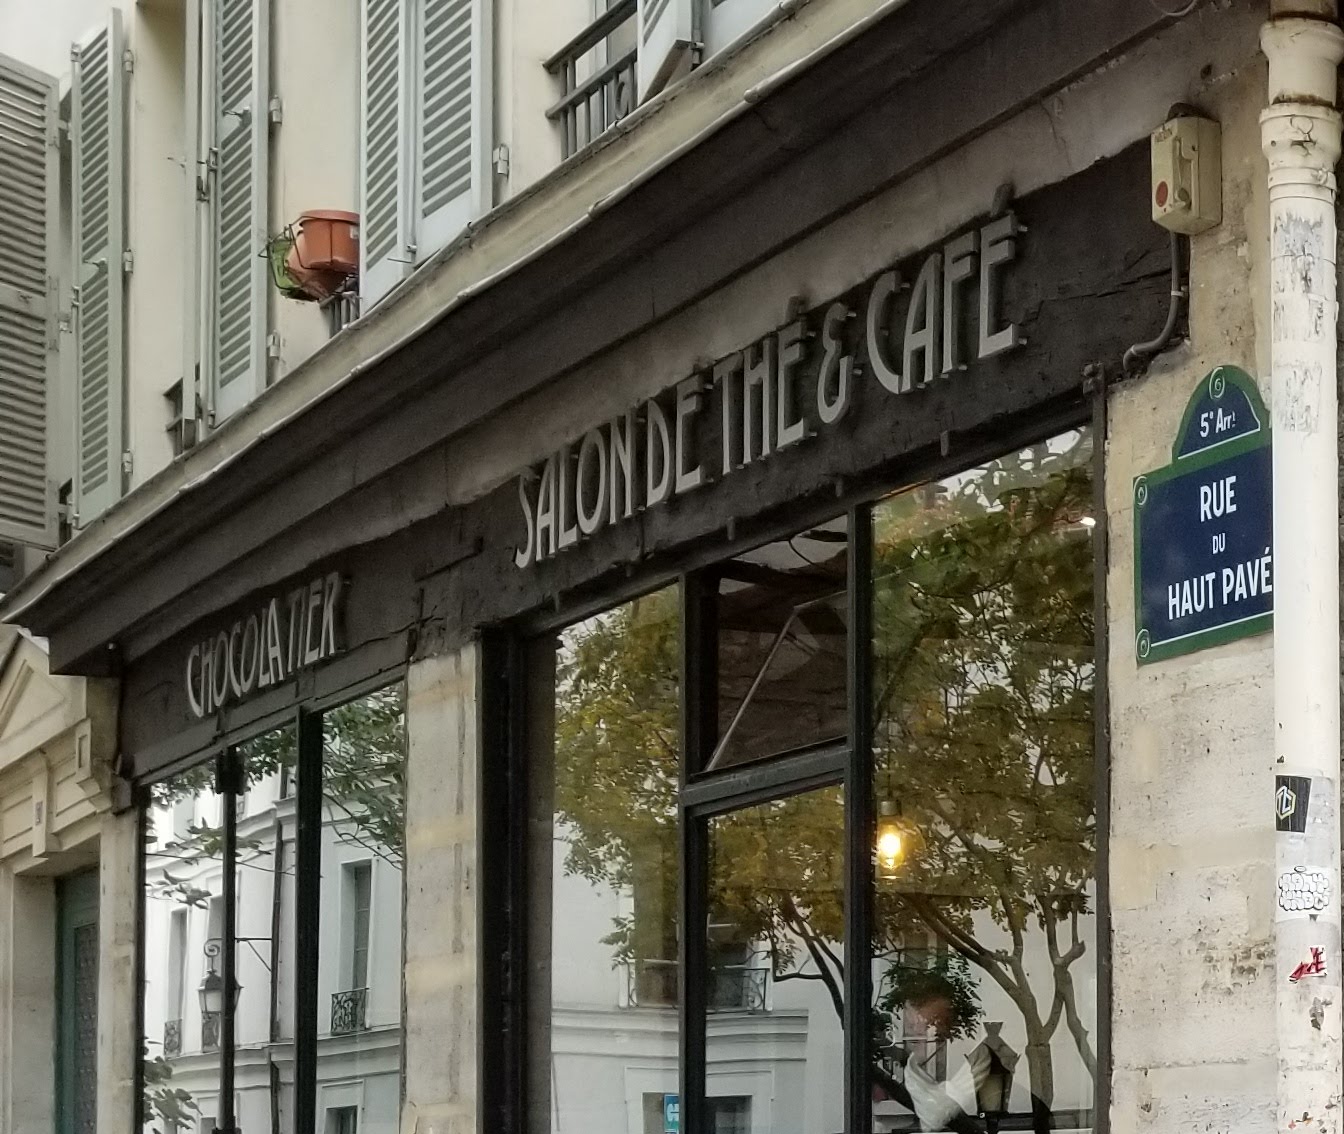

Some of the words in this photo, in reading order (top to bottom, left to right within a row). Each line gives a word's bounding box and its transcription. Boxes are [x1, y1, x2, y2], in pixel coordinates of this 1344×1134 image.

[514, 405, 635, 569] SALON
[647, 372, 705, 508] DE
[817, 302, 853, 424] &
[1200, 476, 1236, 521] RUE
[1212, 532, 1225, 554] DU
[1168, 576, 1214, 620] HAUT
[1221, 548, 1273, 599] PAVÉ
[186, 572, 343, 717] CHOCOLATIER
